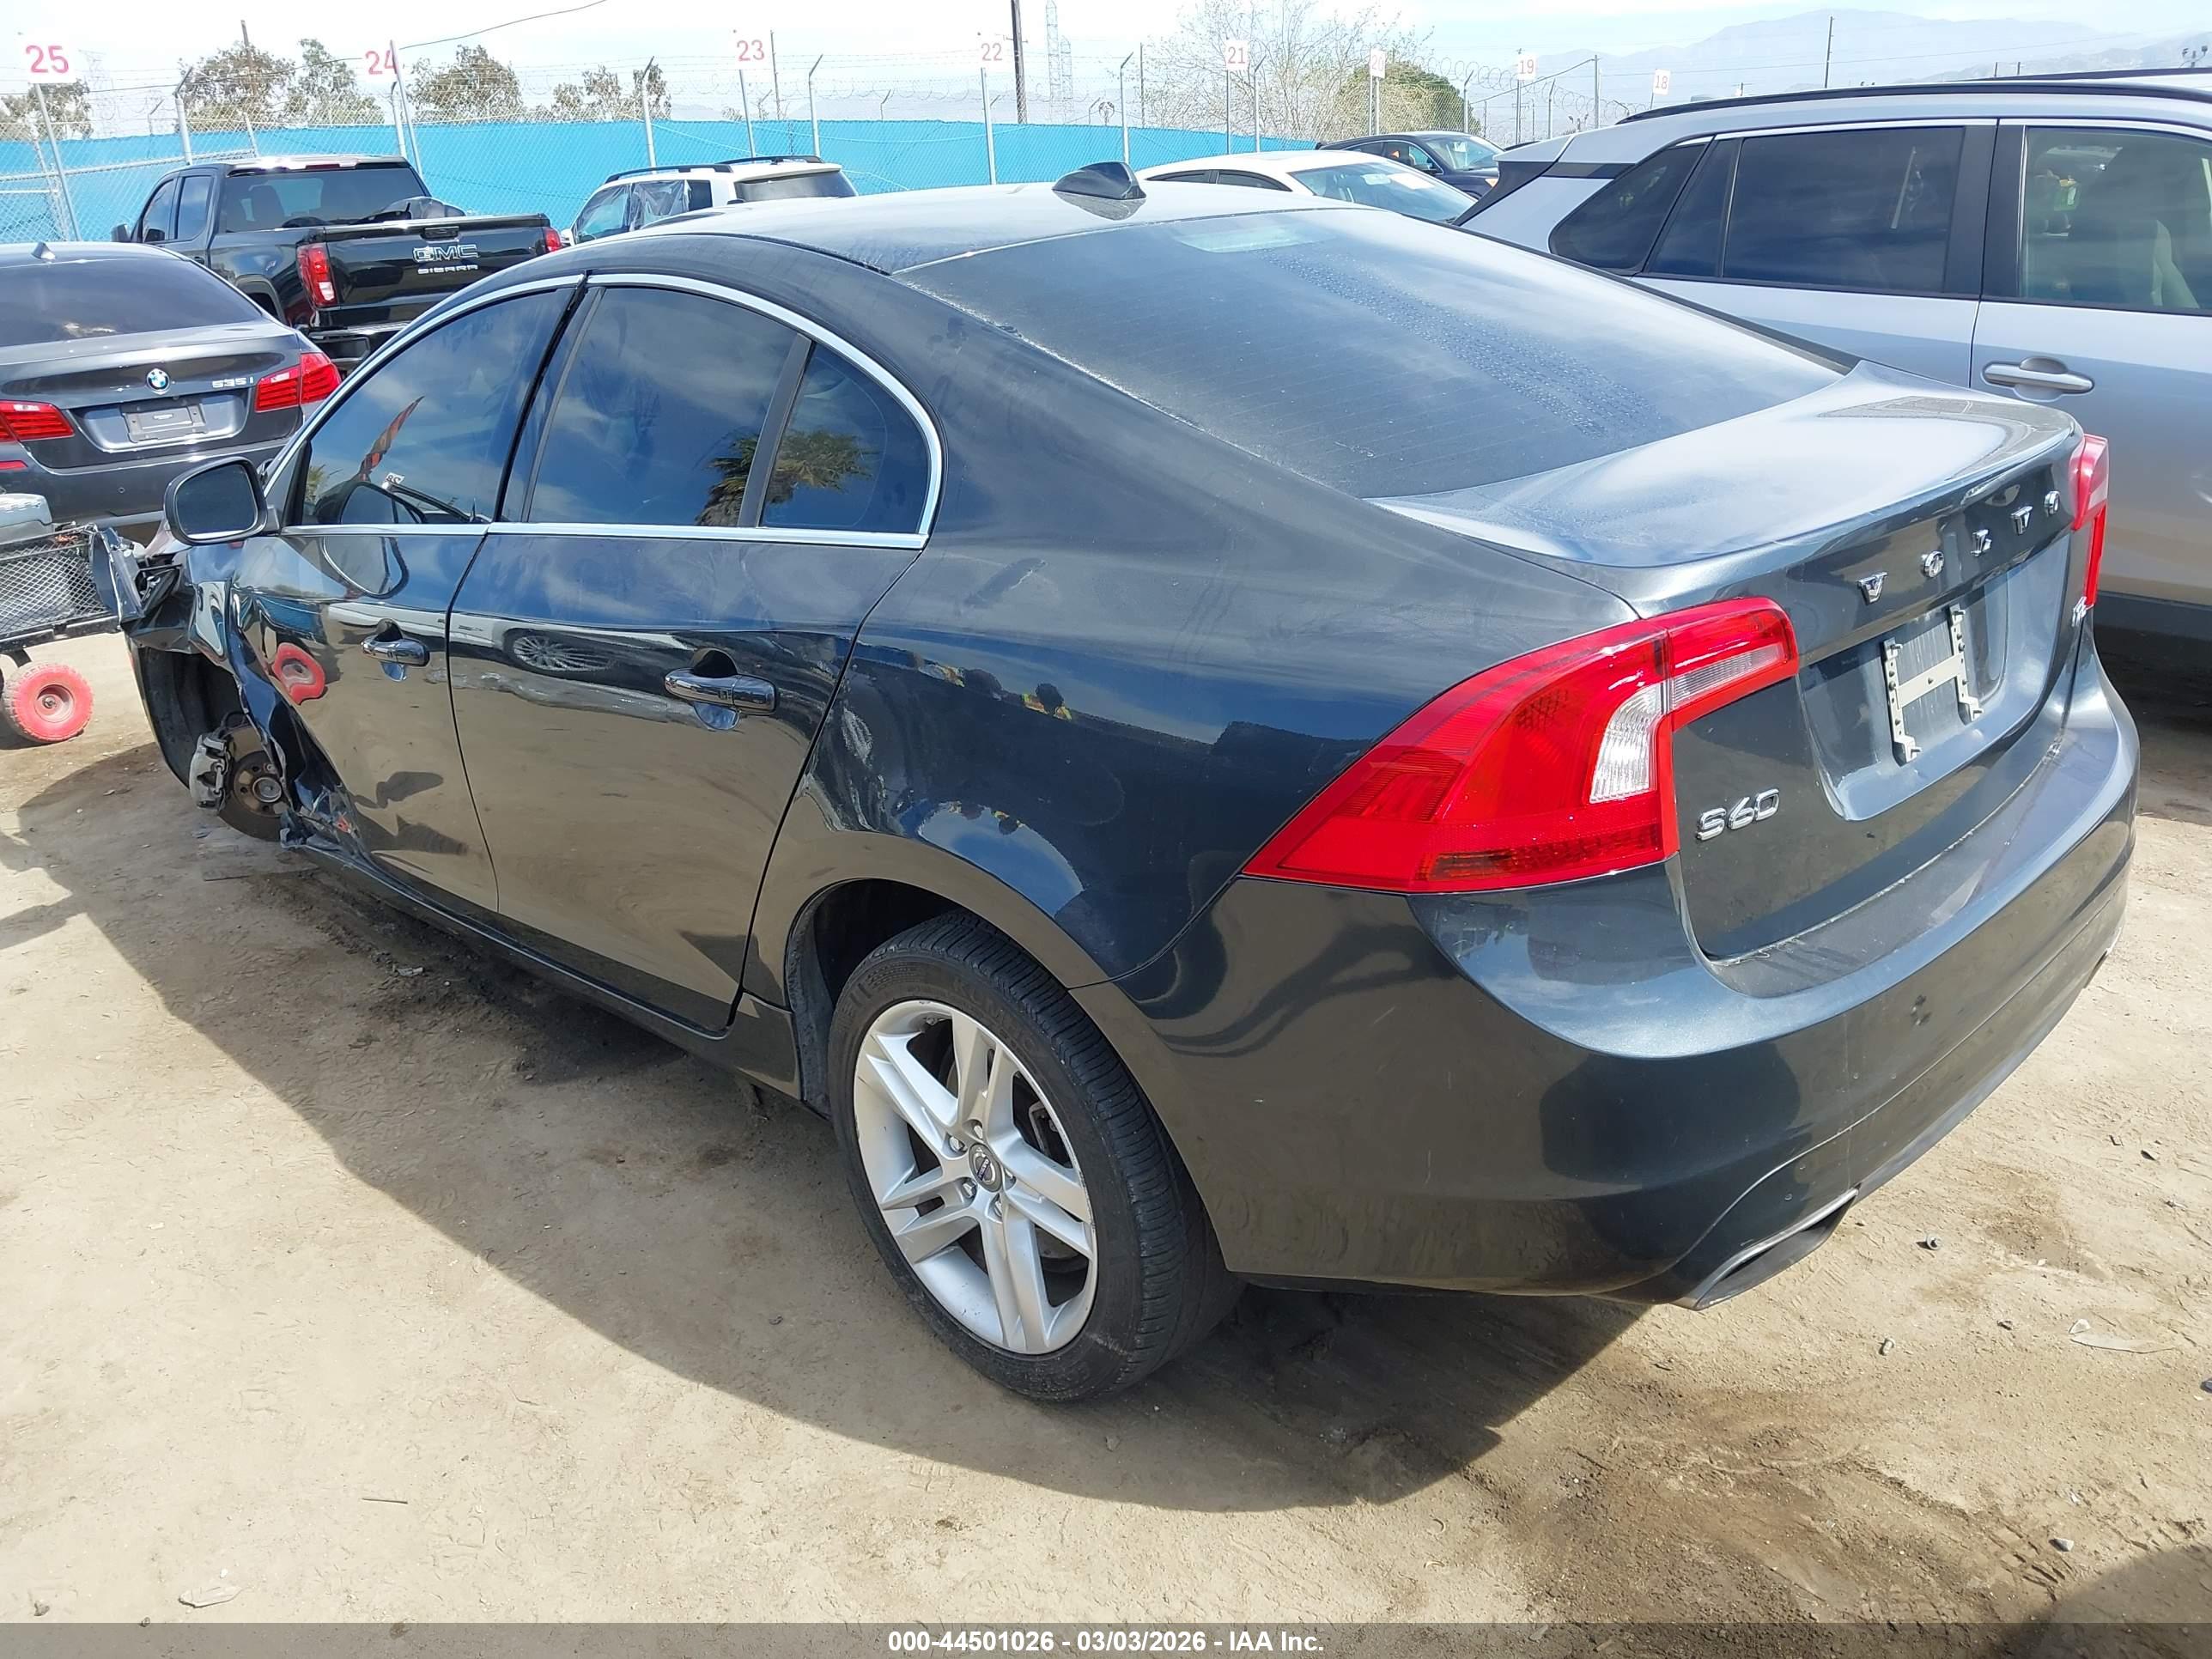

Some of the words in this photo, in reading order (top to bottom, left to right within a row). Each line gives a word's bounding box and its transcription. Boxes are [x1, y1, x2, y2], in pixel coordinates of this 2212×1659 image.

[25, 45, 70, 74] 25
[736, 40, 764, 61] 23
[981, 43, 1003, 61] 22
[1227, 46, 1246, 64] 21
[365, 50, 398, 75] 24
[1519, 59, 1534, 75] 19
[1655, 75, 1668, 89] 18
[413, 244, 479, 263] GMC
[417, 264, 478, 275] SIERRA
[1856, 490, 2061, 605] VOLVO
[1696, 788, 1780, 841] S60
